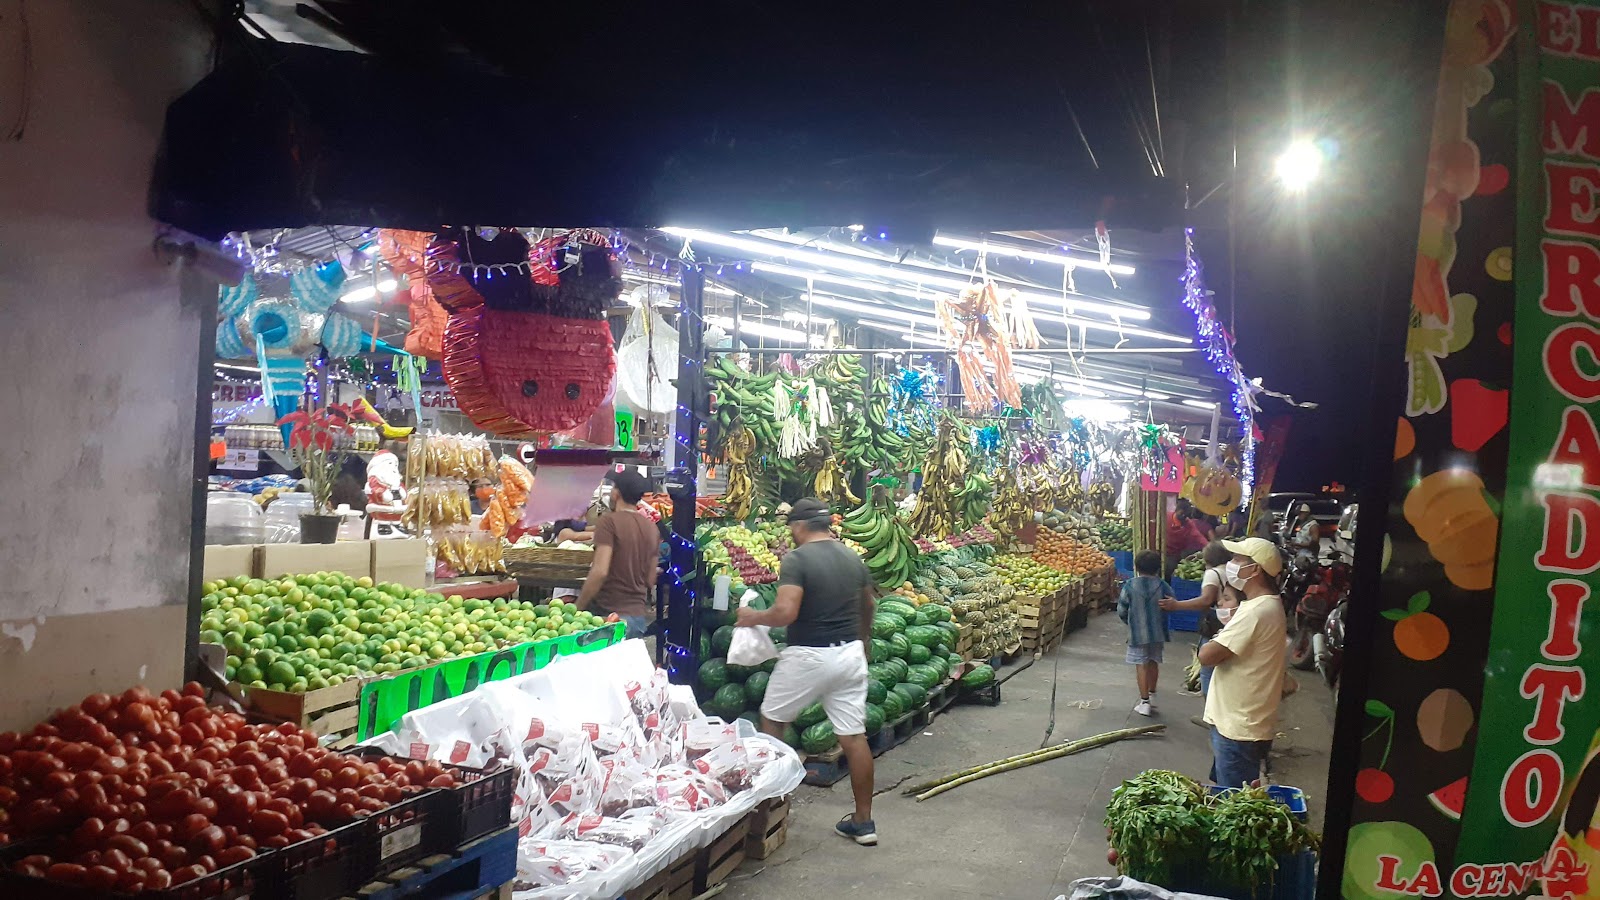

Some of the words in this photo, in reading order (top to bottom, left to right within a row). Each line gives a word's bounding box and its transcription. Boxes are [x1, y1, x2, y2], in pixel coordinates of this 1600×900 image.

[420, 390, 459, 408] CAR
[1500, 77, 1600, 828] MERCADITO
[1375, 855, 1443, 897] LA
